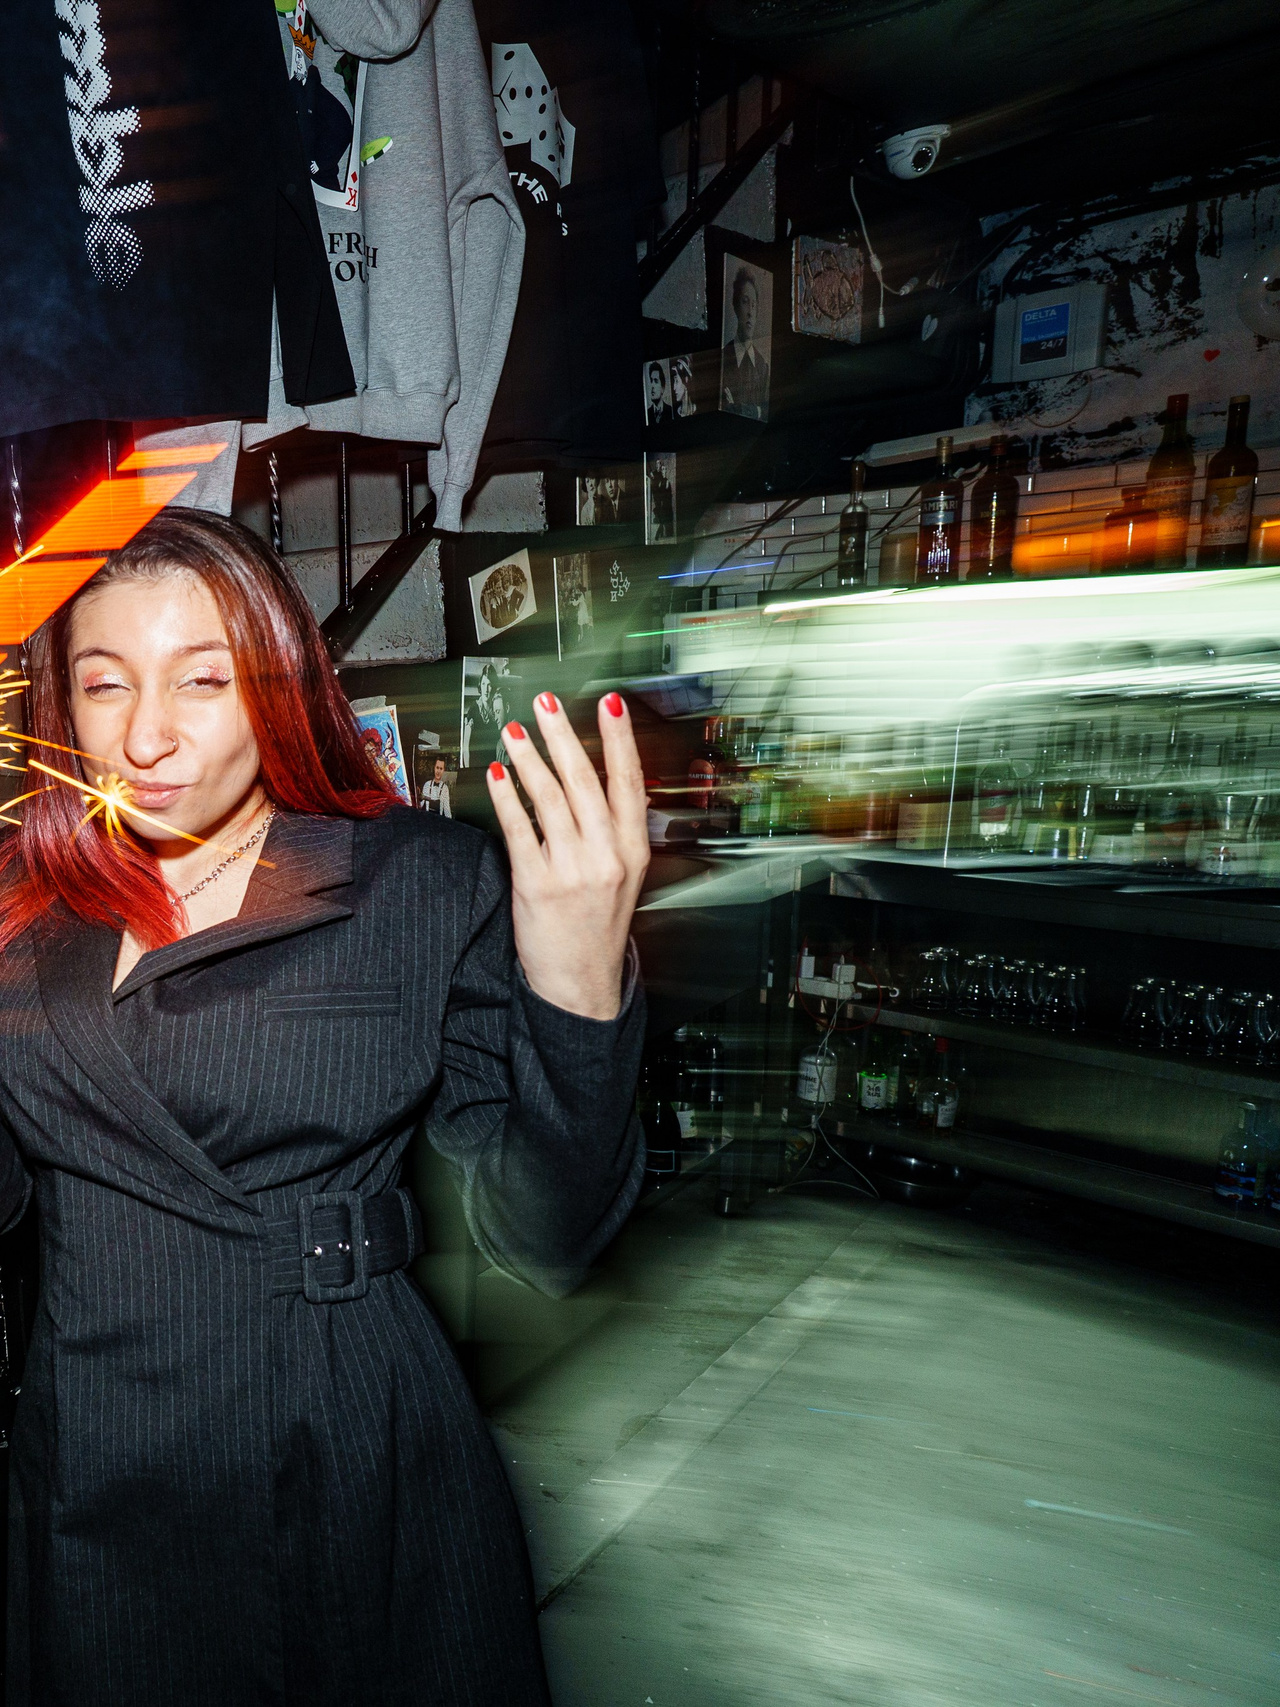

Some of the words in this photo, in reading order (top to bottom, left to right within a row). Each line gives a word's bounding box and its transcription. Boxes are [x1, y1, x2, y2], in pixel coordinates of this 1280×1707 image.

[327, 232, 378, 268] FRH
[1025, 309, 1057, 321] DELTA
[1040, 338, 1064, 350] 24/7
[921, 500, 958, 511] AMPARI
